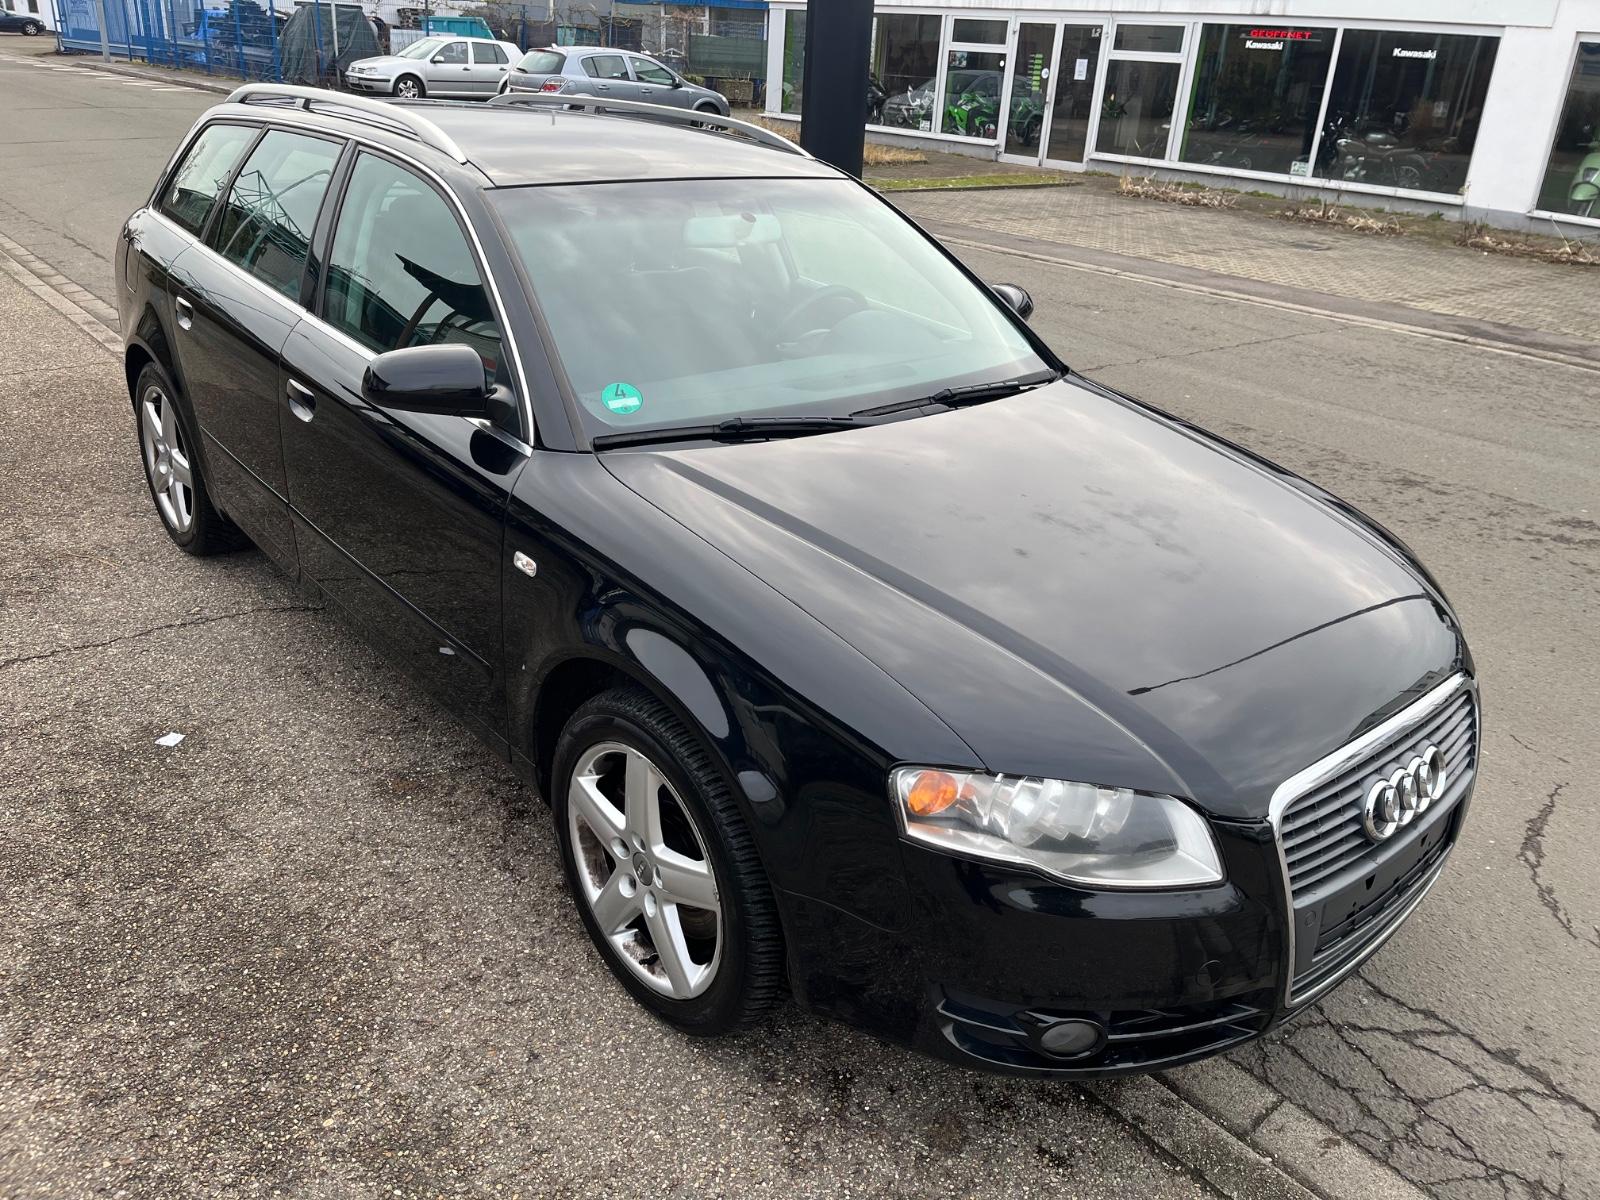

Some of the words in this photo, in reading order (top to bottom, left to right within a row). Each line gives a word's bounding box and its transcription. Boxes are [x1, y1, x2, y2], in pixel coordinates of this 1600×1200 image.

[1245, 40, 1284, 50] Kawasaki
[1392, 47, 1437, 59] Kawasaki
[615, 383, 626, 398] 4
